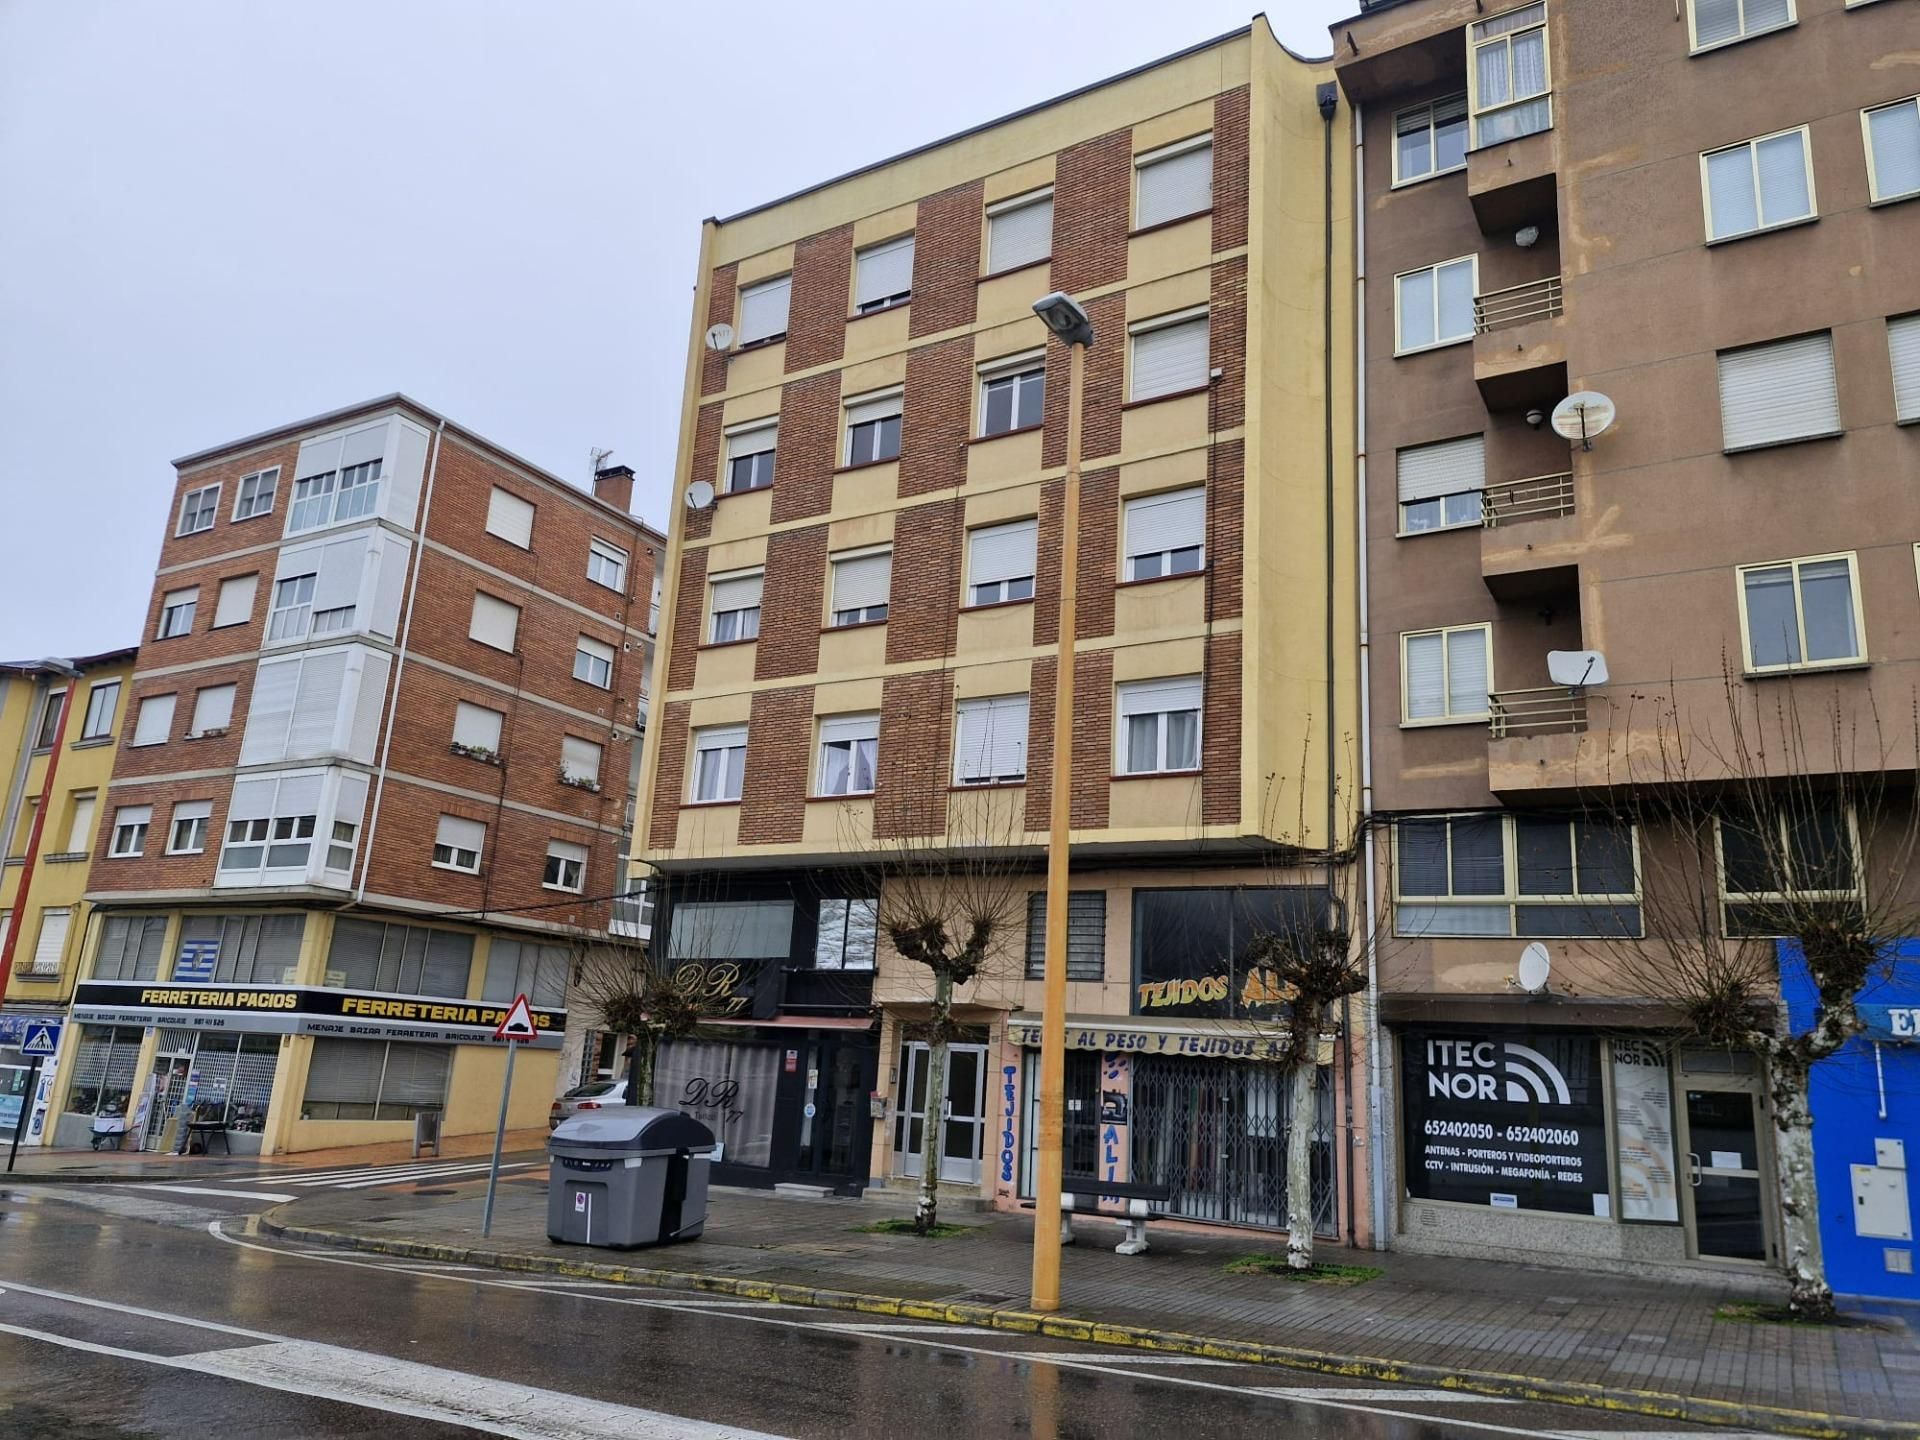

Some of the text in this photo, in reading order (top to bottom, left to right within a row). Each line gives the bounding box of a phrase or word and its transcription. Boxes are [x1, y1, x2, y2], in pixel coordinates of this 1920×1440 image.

[141, 989, 297, 1009] FERRETERIA PACIOS
[725, 997, 749, 1012] 77
[1137, 975, 1230, 1009] TEJIDOS
[342, 998, 479, 1023] FERRETERIA
[307, 1023, 344, 1033] MENAJE
[350, 1026, 381, 1035] BAZAR
[386, 1028, 439, 1039] FERRETERIA
[445, 1032, 486, 1042] BRICOLAJE
[1077, 1031, 1096, 1047] AL
[1105, 1031, 1147, 1050] PESO
[1158, 1034, 1169, 1051] Y
[1179, 1036, 1256, 1056] TEJIDOS
[1427, 1039, 1497, 1068] ITEC
[1614, 1039, 1640, 1052] ITEC
[1614, 1053, 1641, 1066] NOR
[1428, 1071, 1498, 1101] NOR
[679, 1077, 744, 1124] DR 77
[1001, 1066, 1016, 1182] TEJIDOS
[1424, 1120, 1493, 1140] 652402050
[1506, 1125, 1579, 1146] 652402060
[1425, 1145, 1460, 1157] ANTENAS
[1467, 1149, 1507, 1161] PORTEROS
[1507, 1152, 1514, 1161] Y
[1515, 1152, 1582, 1167] VIDEOPORTEROS
[1425, 1160, 1444, 1170] CCTV
[1450, 1162, 1494, 1175] INTRUSIÓN
[1501, 1166, 1550, 1179] MEGAFONÍA
[1557, 1171, 1583, 1183] REDES
